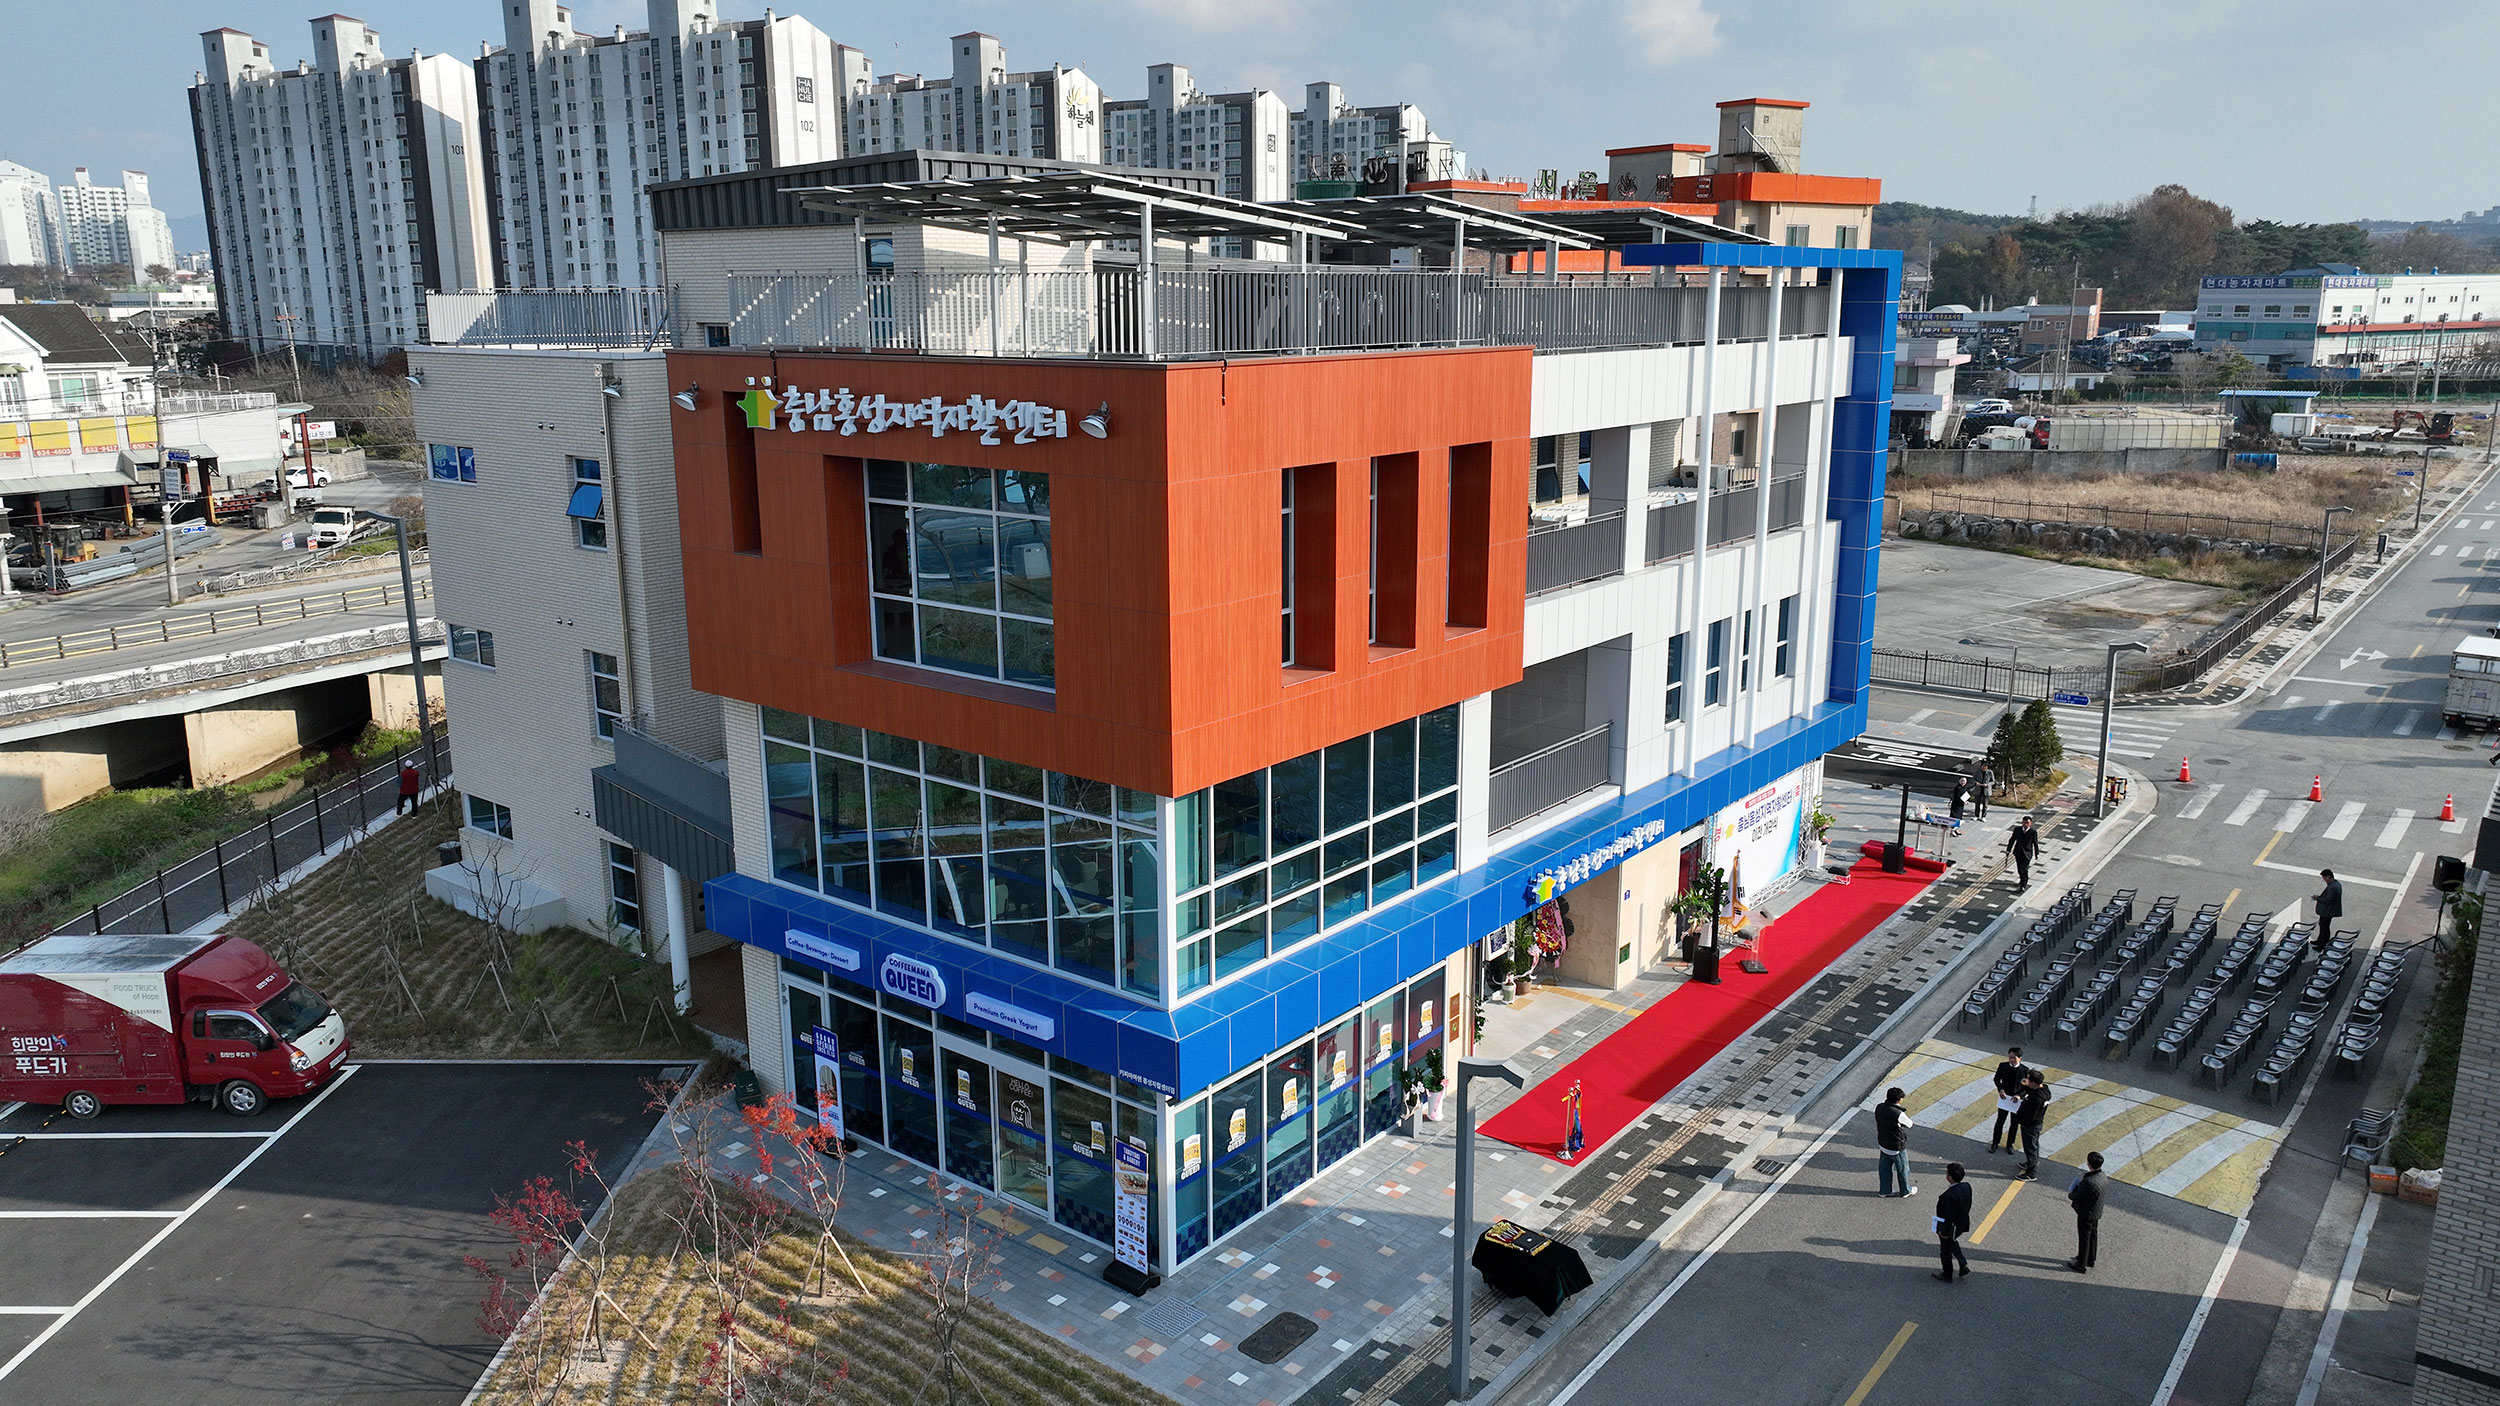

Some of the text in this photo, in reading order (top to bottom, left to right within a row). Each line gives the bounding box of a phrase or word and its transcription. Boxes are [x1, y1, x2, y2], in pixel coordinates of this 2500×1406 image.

[1067, 105, 1094, 128] 하늘채
[800, 120, 814, 132] 102
[451, 145, 464, 155] 101
[2328, 278, 2376, 288] 현대농자재마트
[782, 385, 1067, 445] 충남홍성지역자활센터
[1554, 819, 1664, 891] 충남홍성지역자활센터
[113, 984, 158, 992] FOOD TRUCK
[886, 968, 936, 1003] QUEEN
[141, 993, 160, 1001] Hope
[973, 1002, 1038, 1031] Premium Greek Yogurt
[11, 1036, 53, 1052] 희망의
[15, 1056, 68, 1074] 푸드카
[1072, 1143, 1094, 1158] QUEEN
